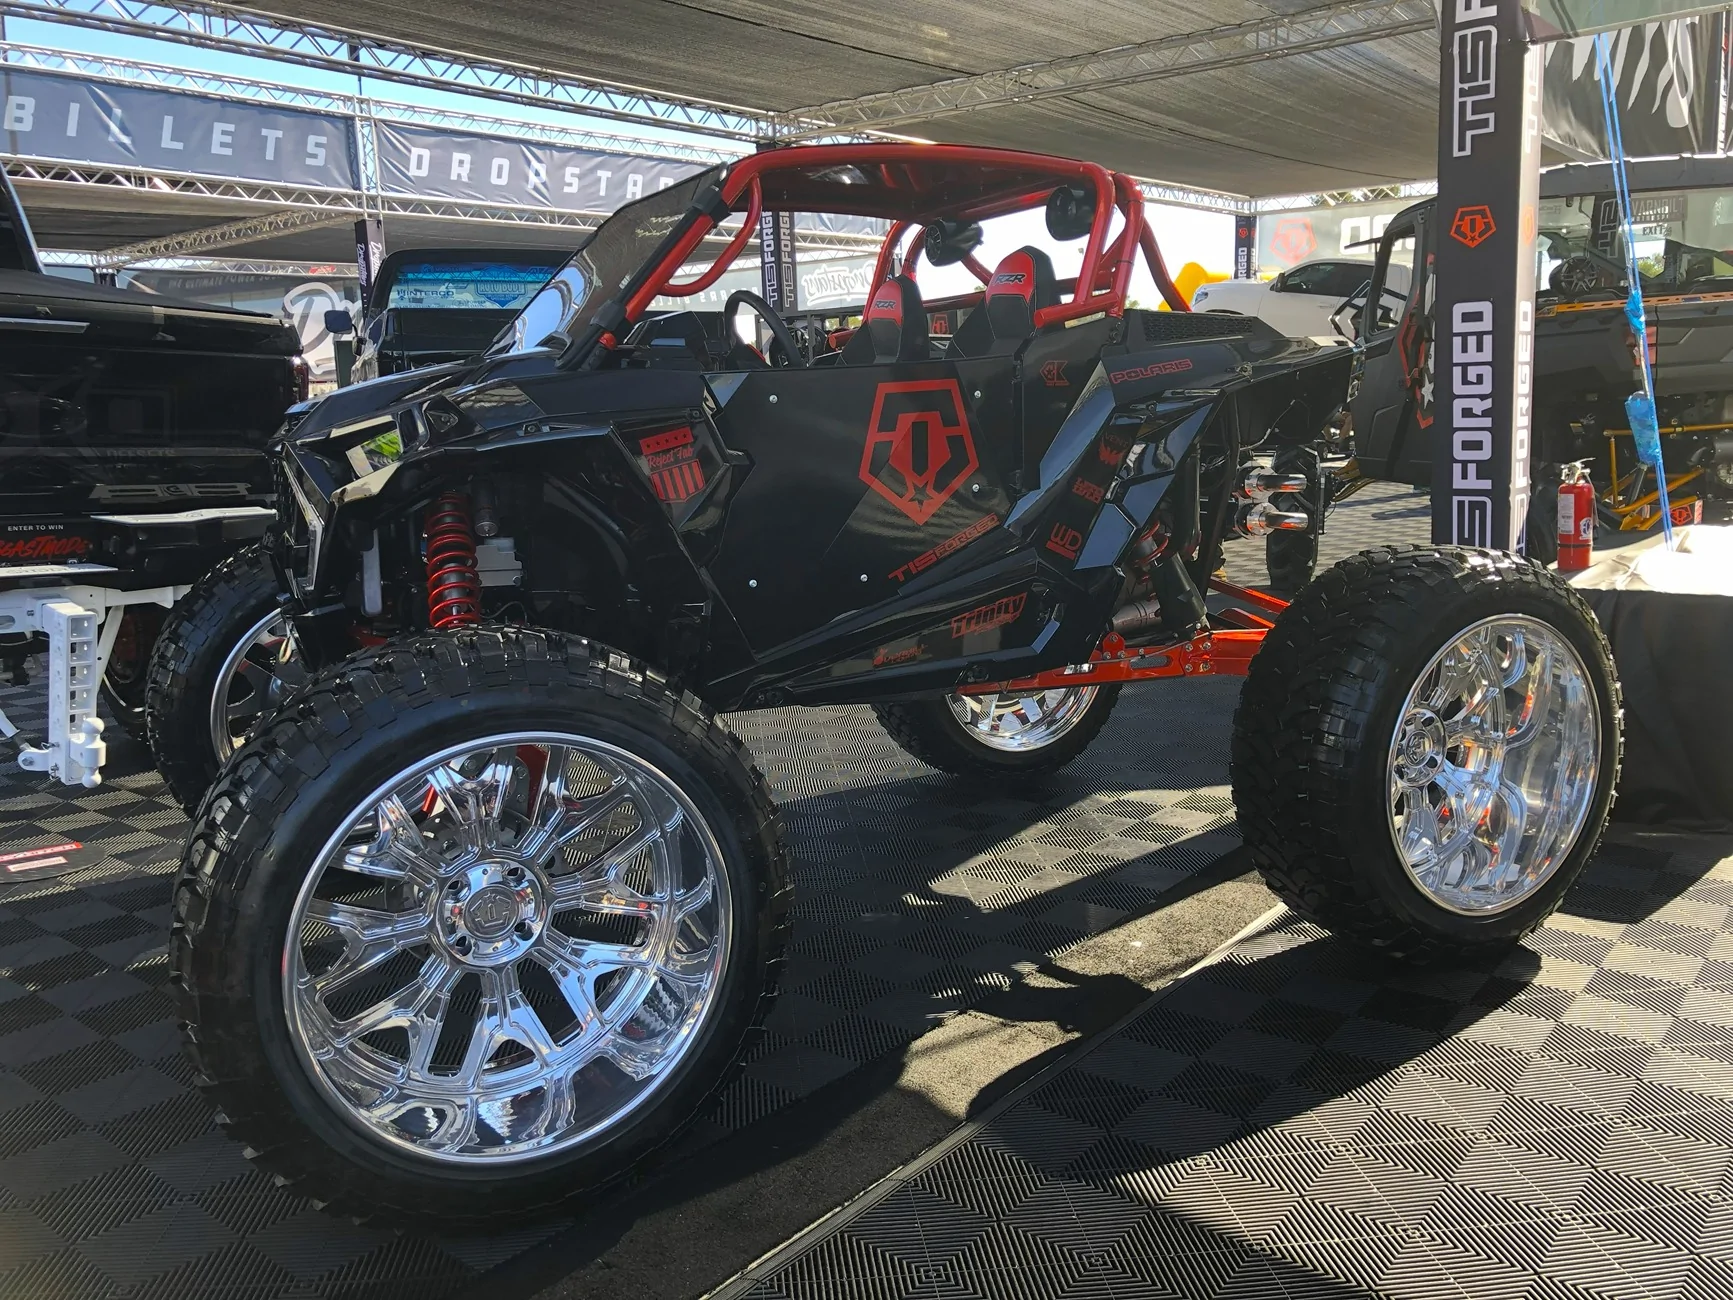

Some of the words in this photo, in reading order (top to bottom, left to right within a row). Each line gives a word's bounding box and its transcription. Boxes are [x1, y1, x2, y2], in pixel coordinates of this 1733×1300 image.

[3, 95, 328, 167] BILLETS
[994, 272, 1026, 285] RZR
[874, 300, 896, 309] RZR
[1109, 359, 1193, 384] POLARIS
